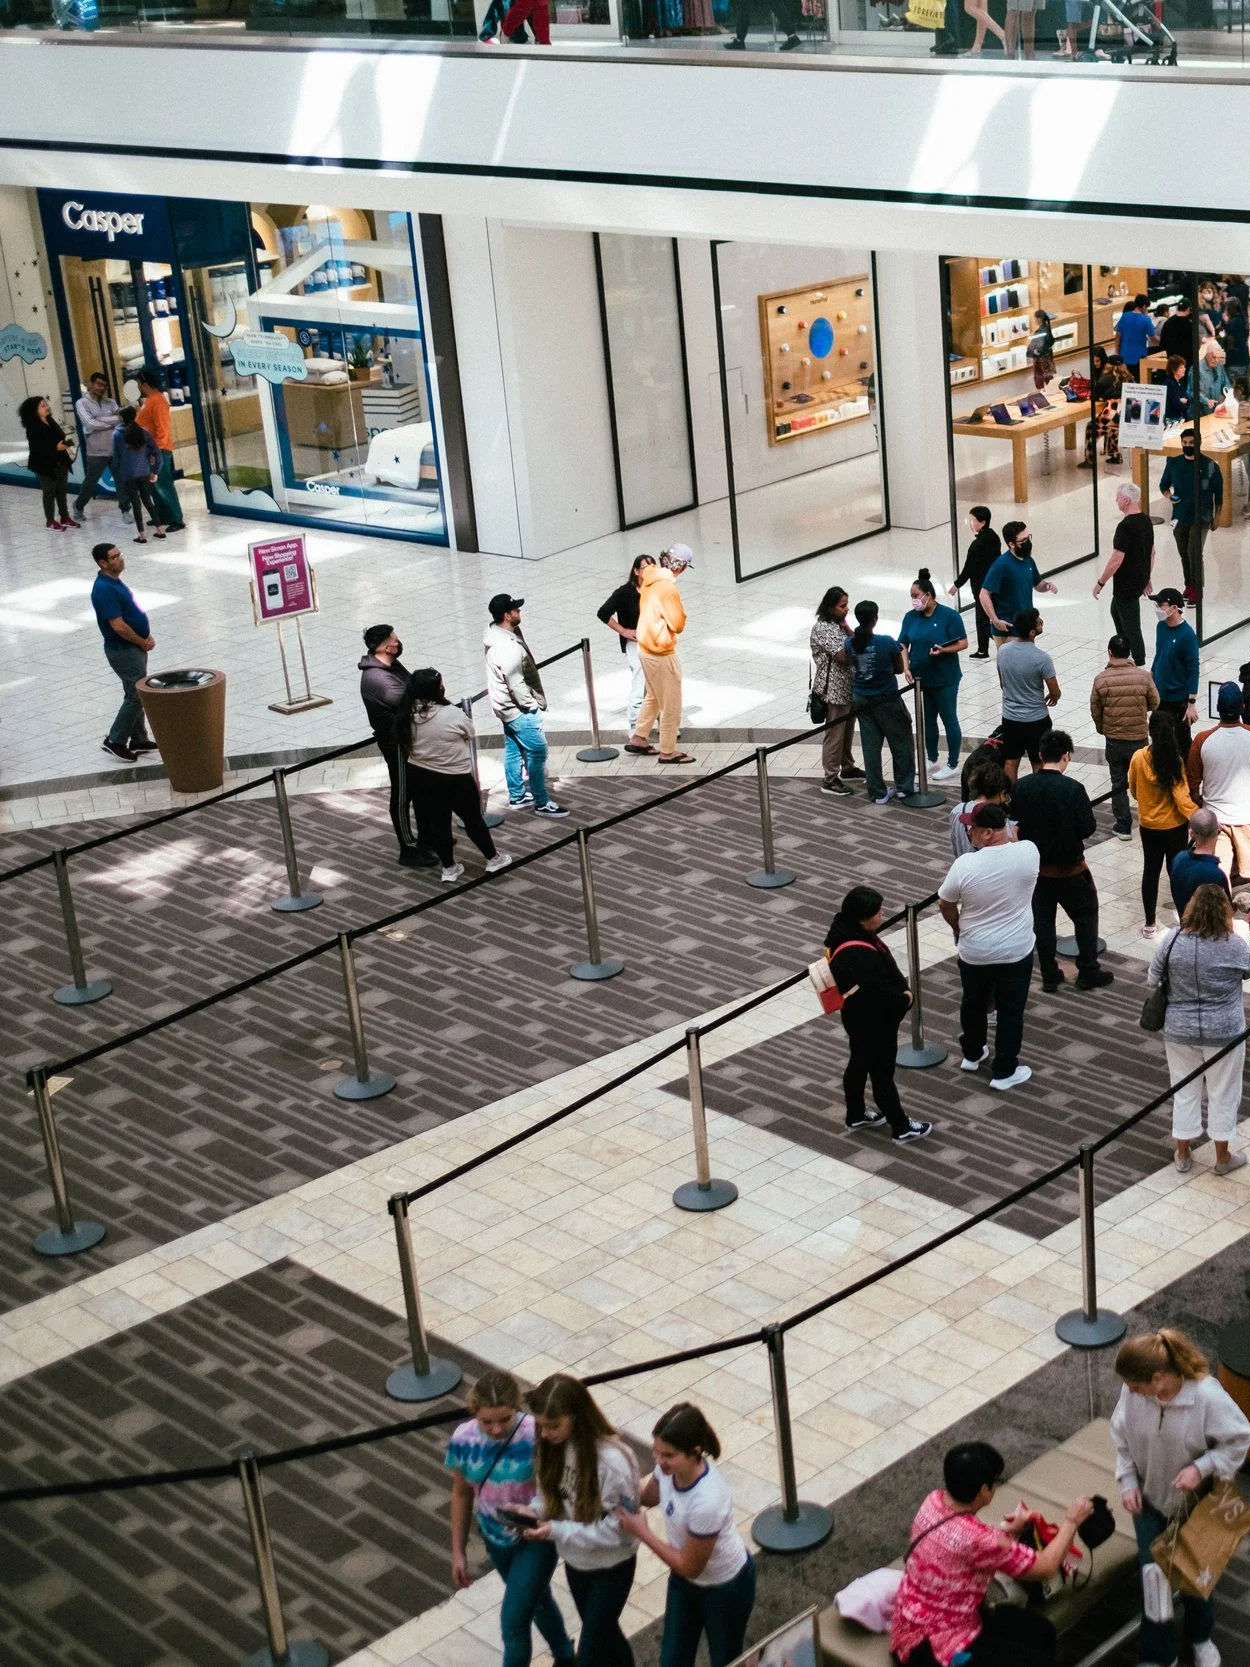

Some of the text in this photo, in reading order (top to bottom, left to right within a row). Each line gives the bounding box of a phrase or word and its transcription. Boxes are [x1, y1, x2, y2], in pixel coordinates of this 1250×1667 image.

[62, 201, 145, 242] Casper
[248, 361, 271, 370] EVERY
[273, 363, 303, 374] SEASON
[306, 480, 341, 495] Casper
